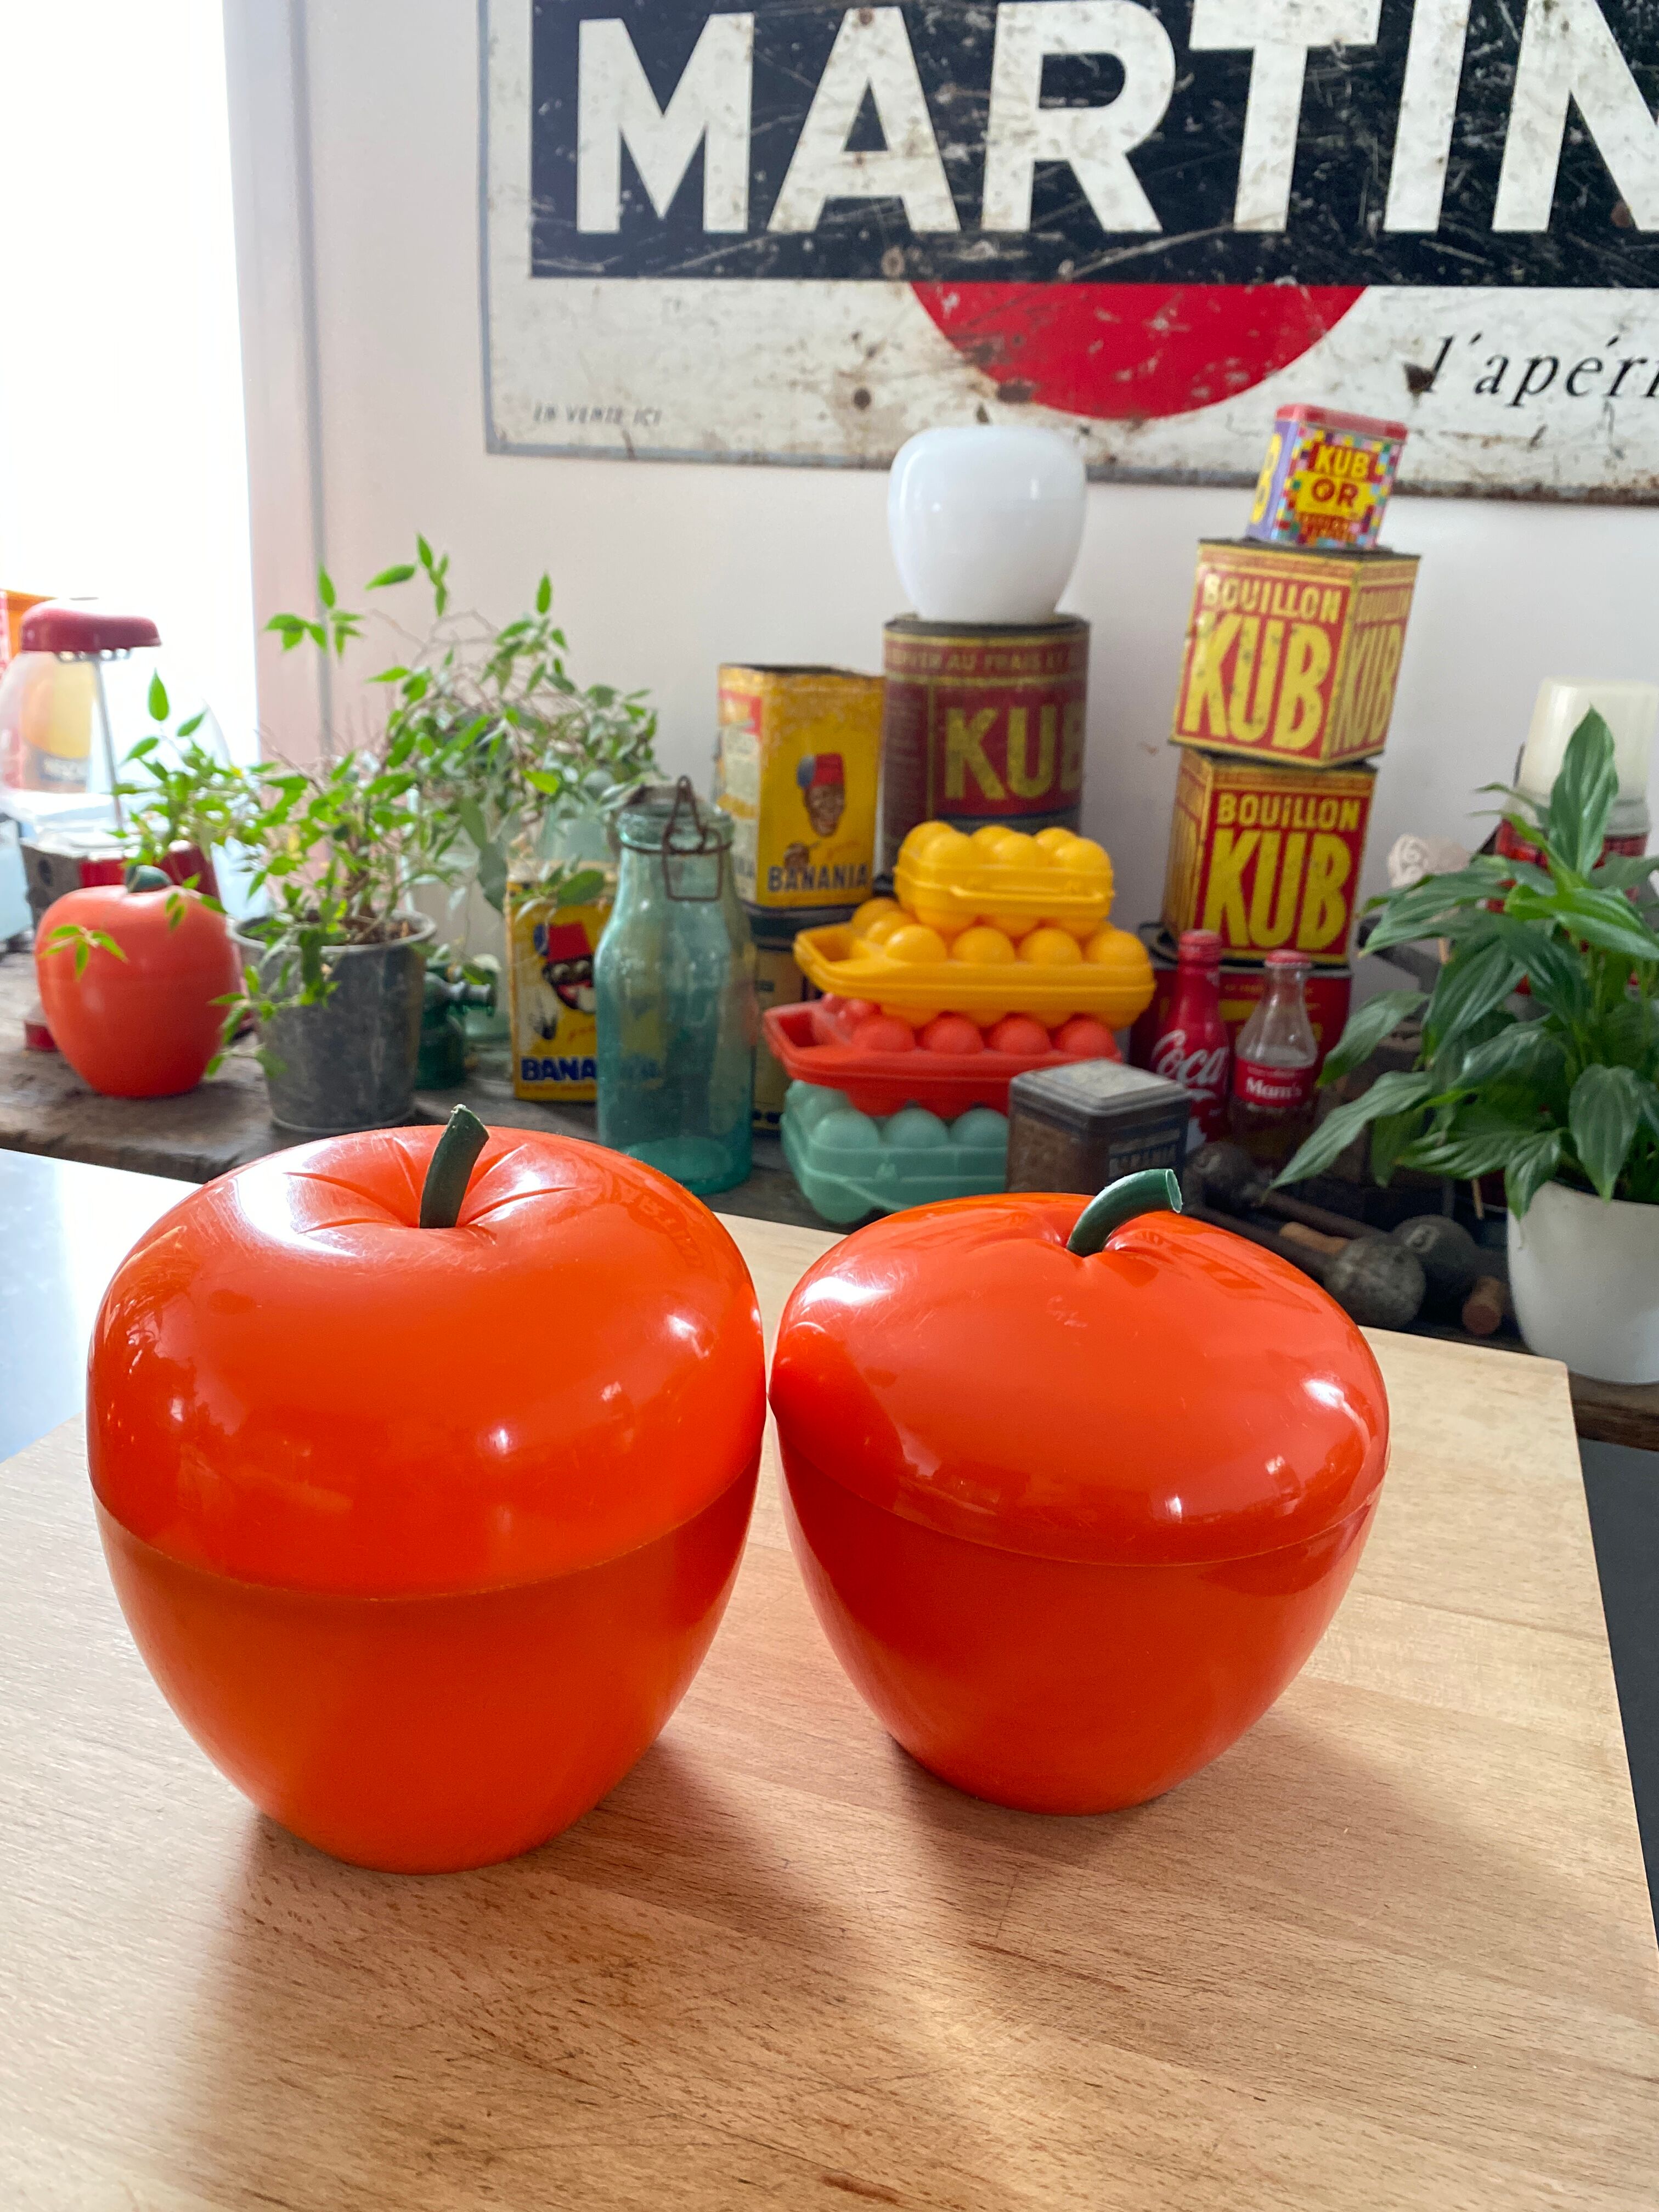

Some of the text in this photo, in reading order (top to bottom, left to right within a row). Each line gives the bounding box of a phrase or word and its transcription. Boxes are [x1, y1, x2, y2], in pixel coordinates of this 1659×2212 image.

[1315, 445, 1369, 477] KUB
[1311, 478, 1358, 507] OR
[1203, 573, 1342, 624] BOUILLON
[1182, 611, 1332, 750] KUB
[1216, 792, 1361, 831] BOUILLON
[768, 862, 868, 891] BANANIA
[1203, 828, 1352, 950] KUB
[522, 1057, 597, 1081] BANA
[1150, 1029, 1229, 1086] Coca
